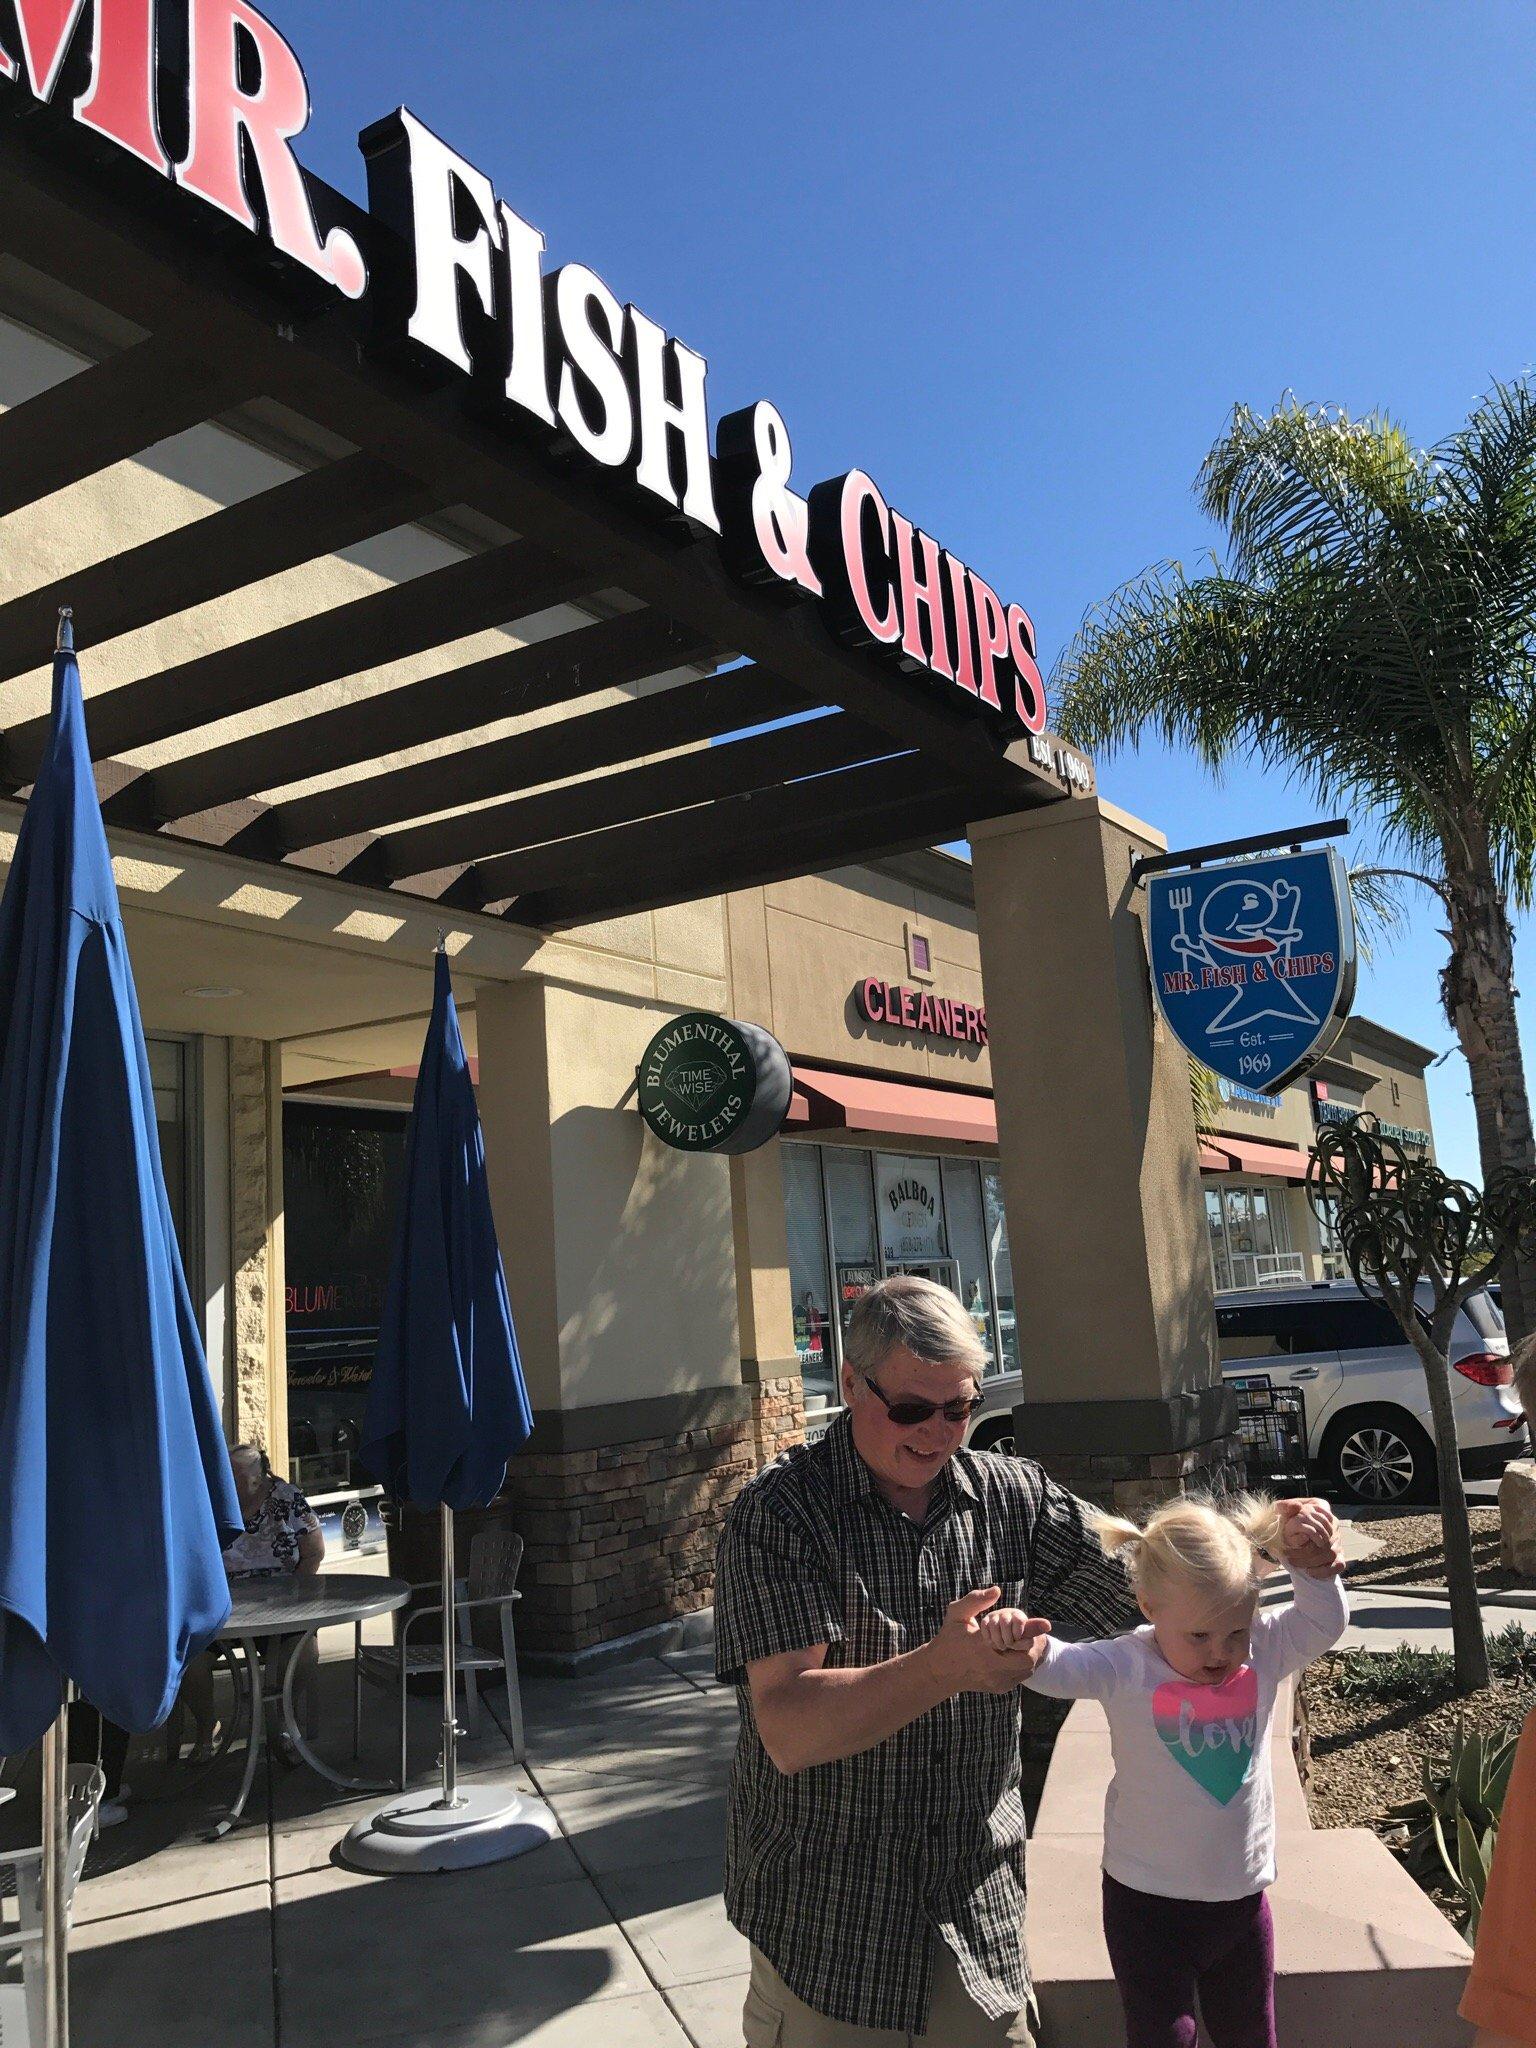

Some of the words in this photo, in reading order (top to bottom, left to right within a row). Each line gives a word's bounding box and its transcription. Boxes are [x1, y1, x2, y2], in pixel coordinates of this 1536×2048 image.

[401, 104, 722, 536] FISH
[751, 399, 825, 599] &
[840, 467, 1048, 736] CHIPS
[1057, 748, 1090, 789] 1969
[1163, 971, 1199, 994] MR.
[1201, 963, 1248, 990] FISH
[1252, 960, 1268, 983] &
[1272, 952, 1336, 979] CHIPS
[646, 1022, 746, 1088] BLUMENTHAL
[1239, 1031, 1266, 1048] Est.
[679, 1068, 712, 1083] TIME
[1238, 1052, 1272, 1075] 1969
[679, 1081, 714, 1095] WISE
[647, 1094, 742, 1141] JEWELERS
[888, 1180, 935, 1217] BALBOA
